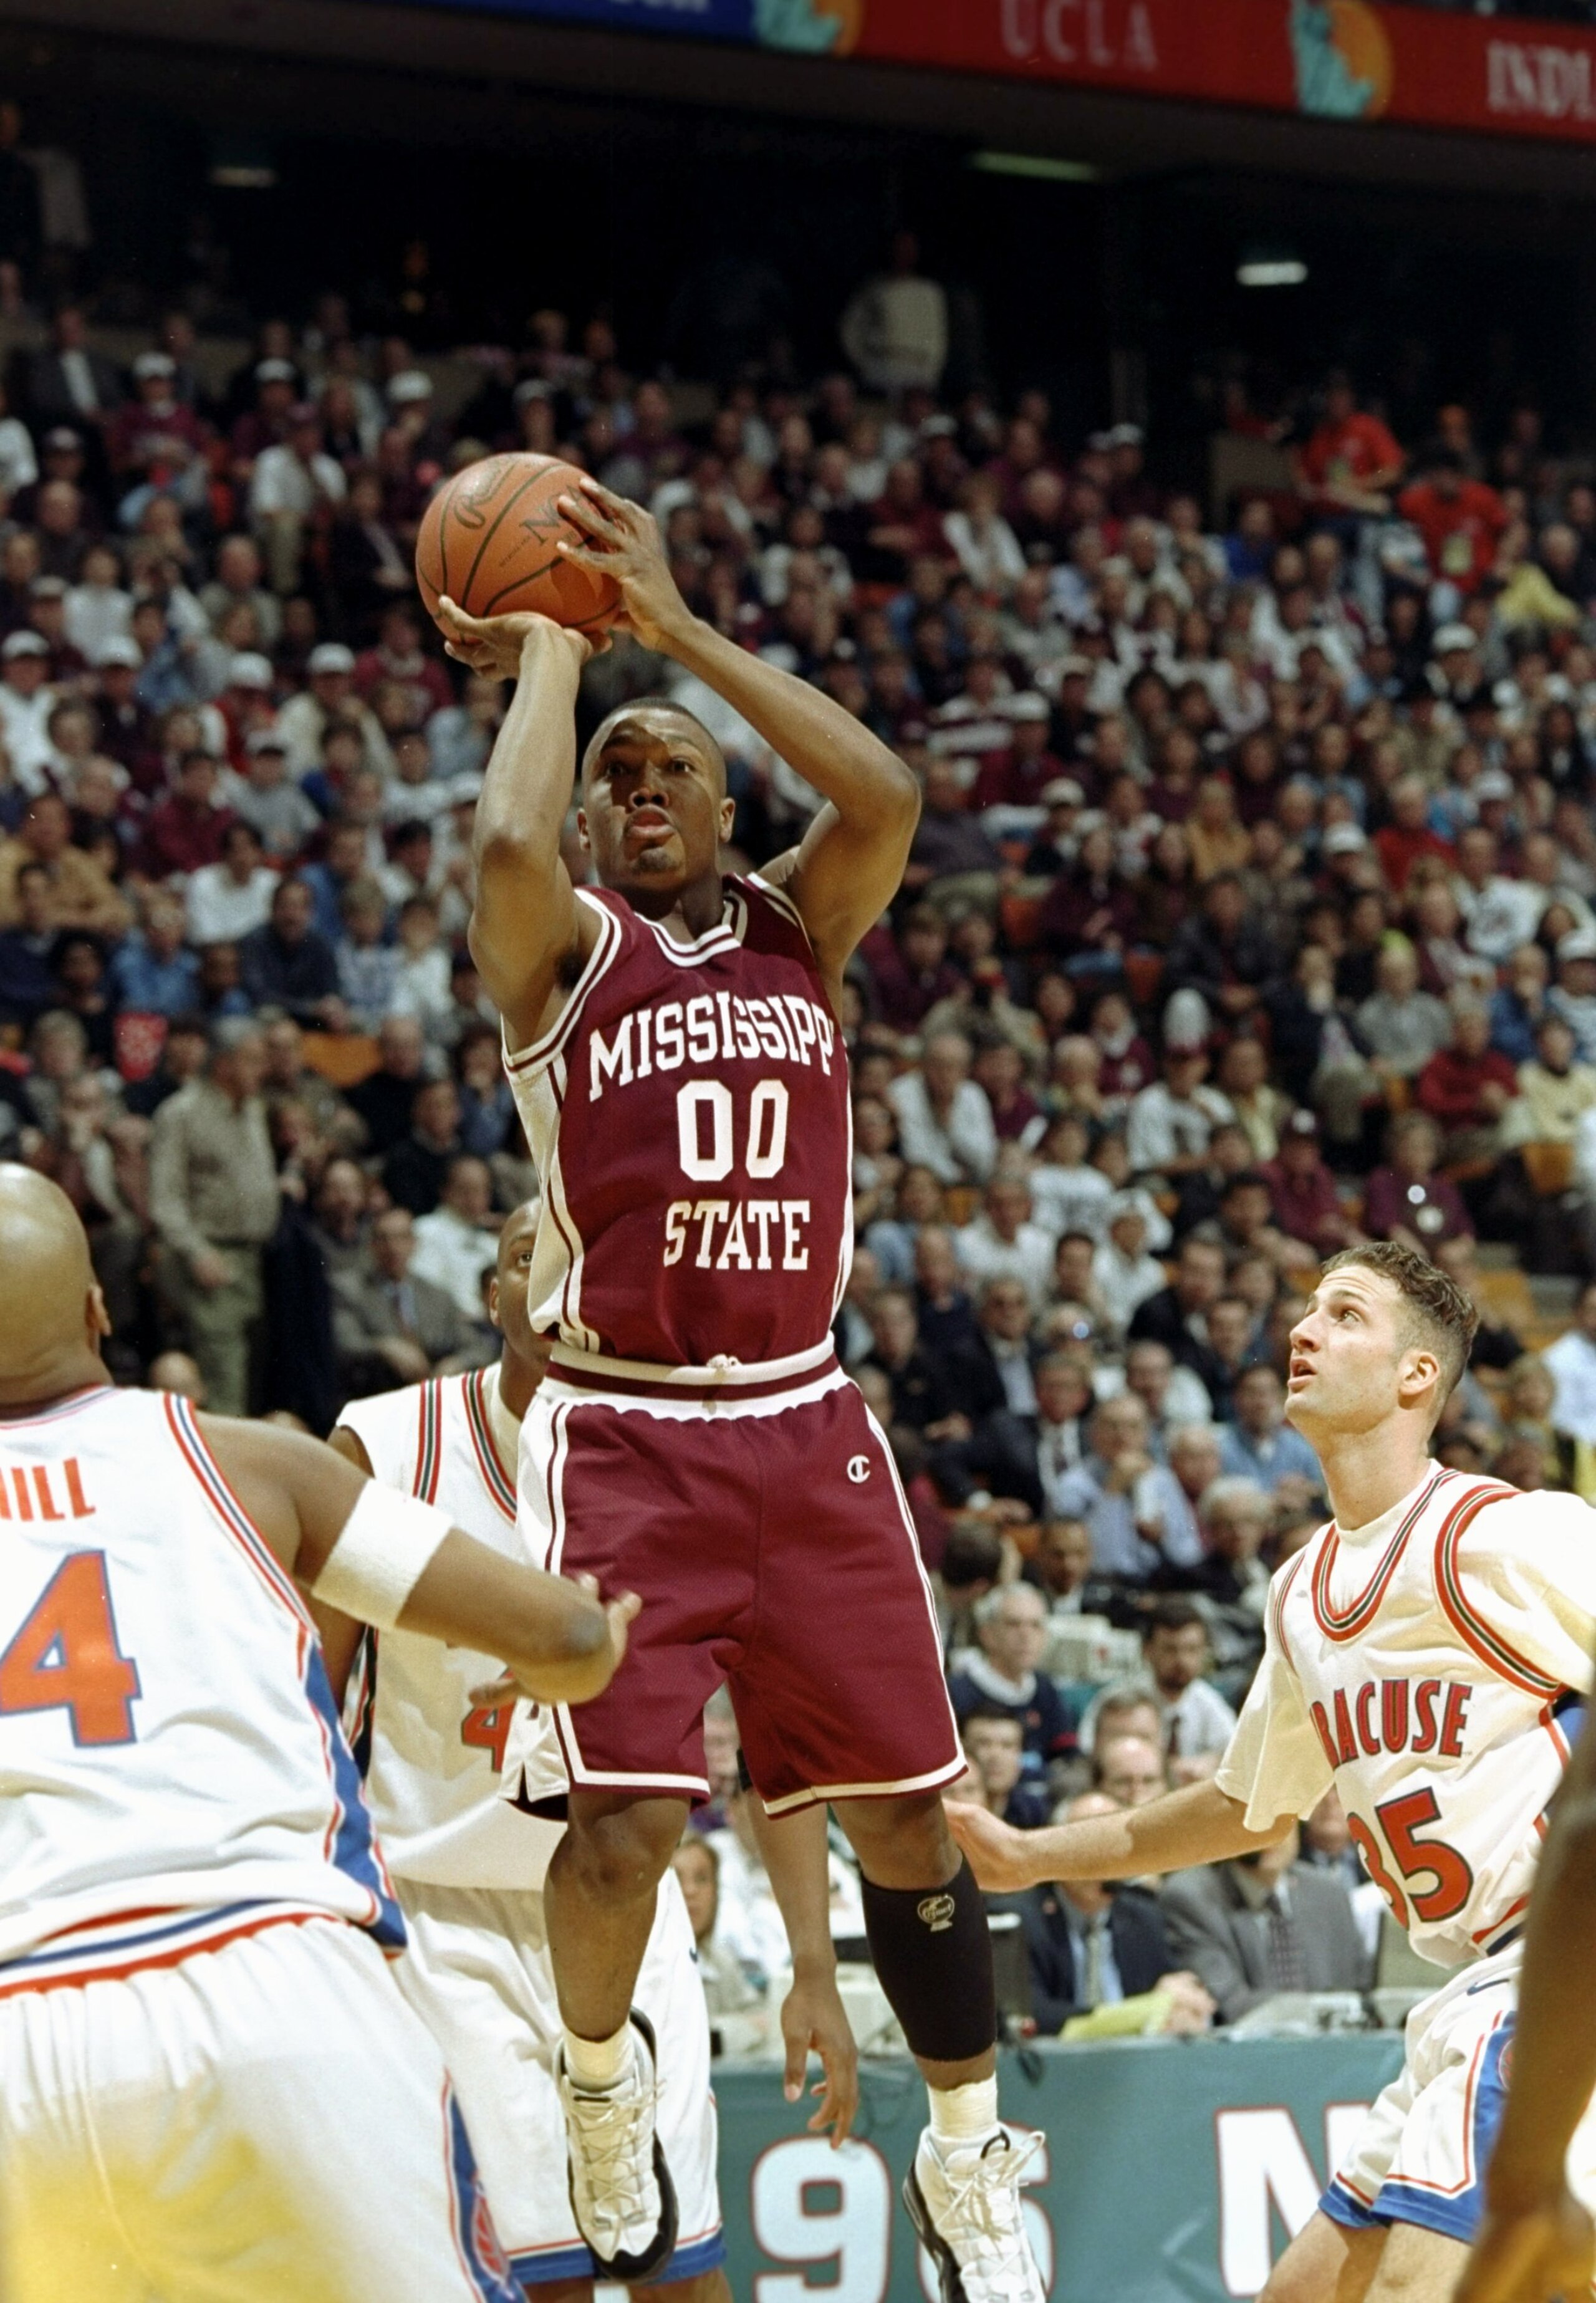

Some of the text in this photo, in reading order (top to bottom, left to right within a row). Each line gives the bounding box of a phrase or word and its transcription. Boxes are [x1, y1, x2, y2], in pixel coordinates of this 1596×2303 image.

[1000, 0, 1158, 73] UCLA
[589, 990, 834, 1102] MISSISSIPP
[677, 1079, 789, 1181] 00
[663, 1200, 810, 1270] STATE
[0, 1549, 143, 1748] 4
